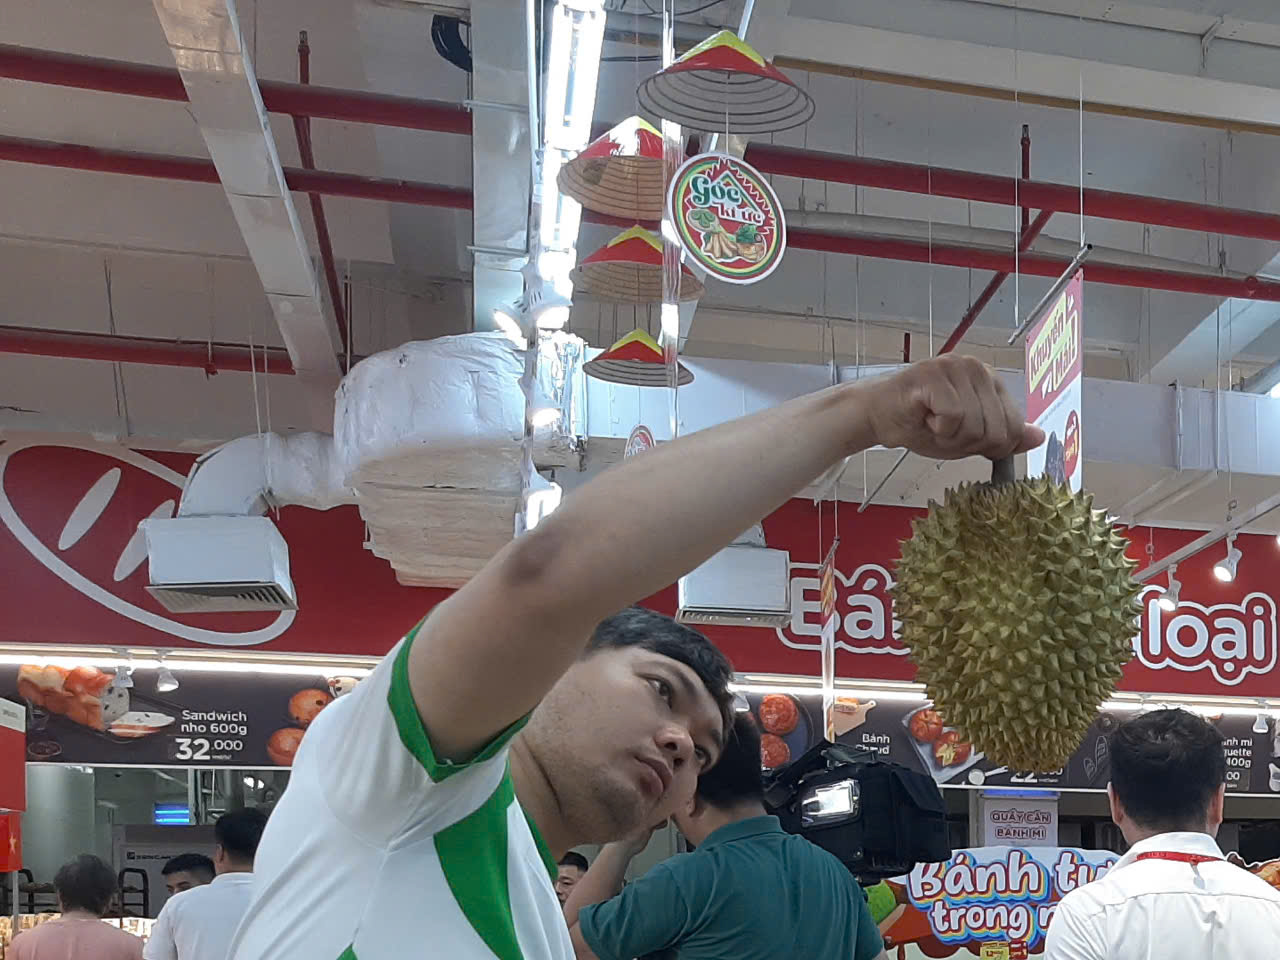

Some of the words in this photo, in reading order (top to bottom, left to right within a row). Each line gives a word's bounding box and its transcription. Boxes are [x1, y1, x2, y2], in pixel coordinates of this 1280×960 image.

[1148, 598, 1265, 673] loại
[181, 709, 247, 722] Sandwich
[180, 722, 207, 733] nho
[210, 723, 247, 736] 600g
[862, 732, 890, 744] Bánh
[175, 737, 244, 760] 32.000
[909, 849, 1042, 899] Bánh
[931, 901, 1029, 940] trong
